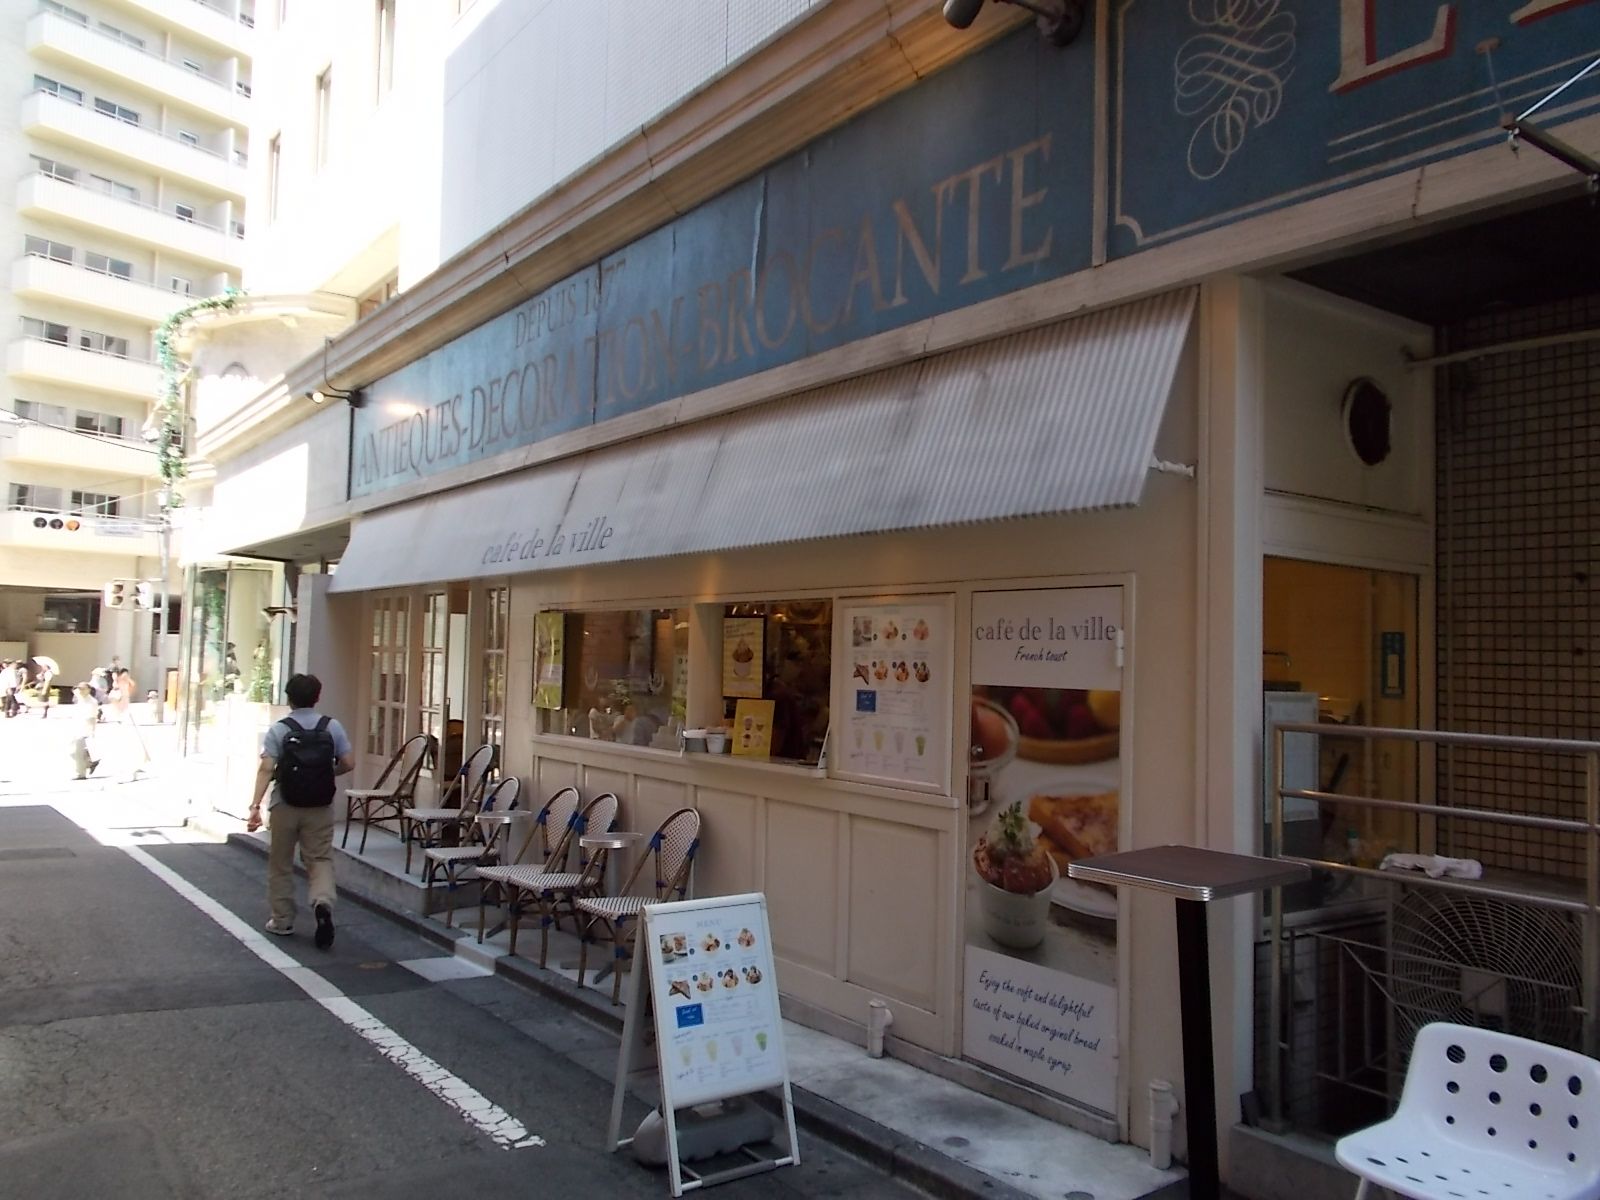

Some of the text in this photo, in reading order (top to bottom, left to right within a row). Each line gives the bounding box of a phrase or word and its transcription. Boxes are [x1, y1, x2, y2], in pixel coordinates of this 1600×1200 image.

[515, 283, 577, 349] DEPUIS
[481, 516, 613, 565] café de la ville
[975, 616, 1116, 640] café de la ville
[1014, 645, 1069, 662] French toast
[979, 969, 1094, 1021] Enjoy the soft and delightful
[972, 998, 1101, 1051] taste of our baked original bread
[988, 1033, 1017, 1050] soaked
[1023, 1047, 1046, 1062] maple
